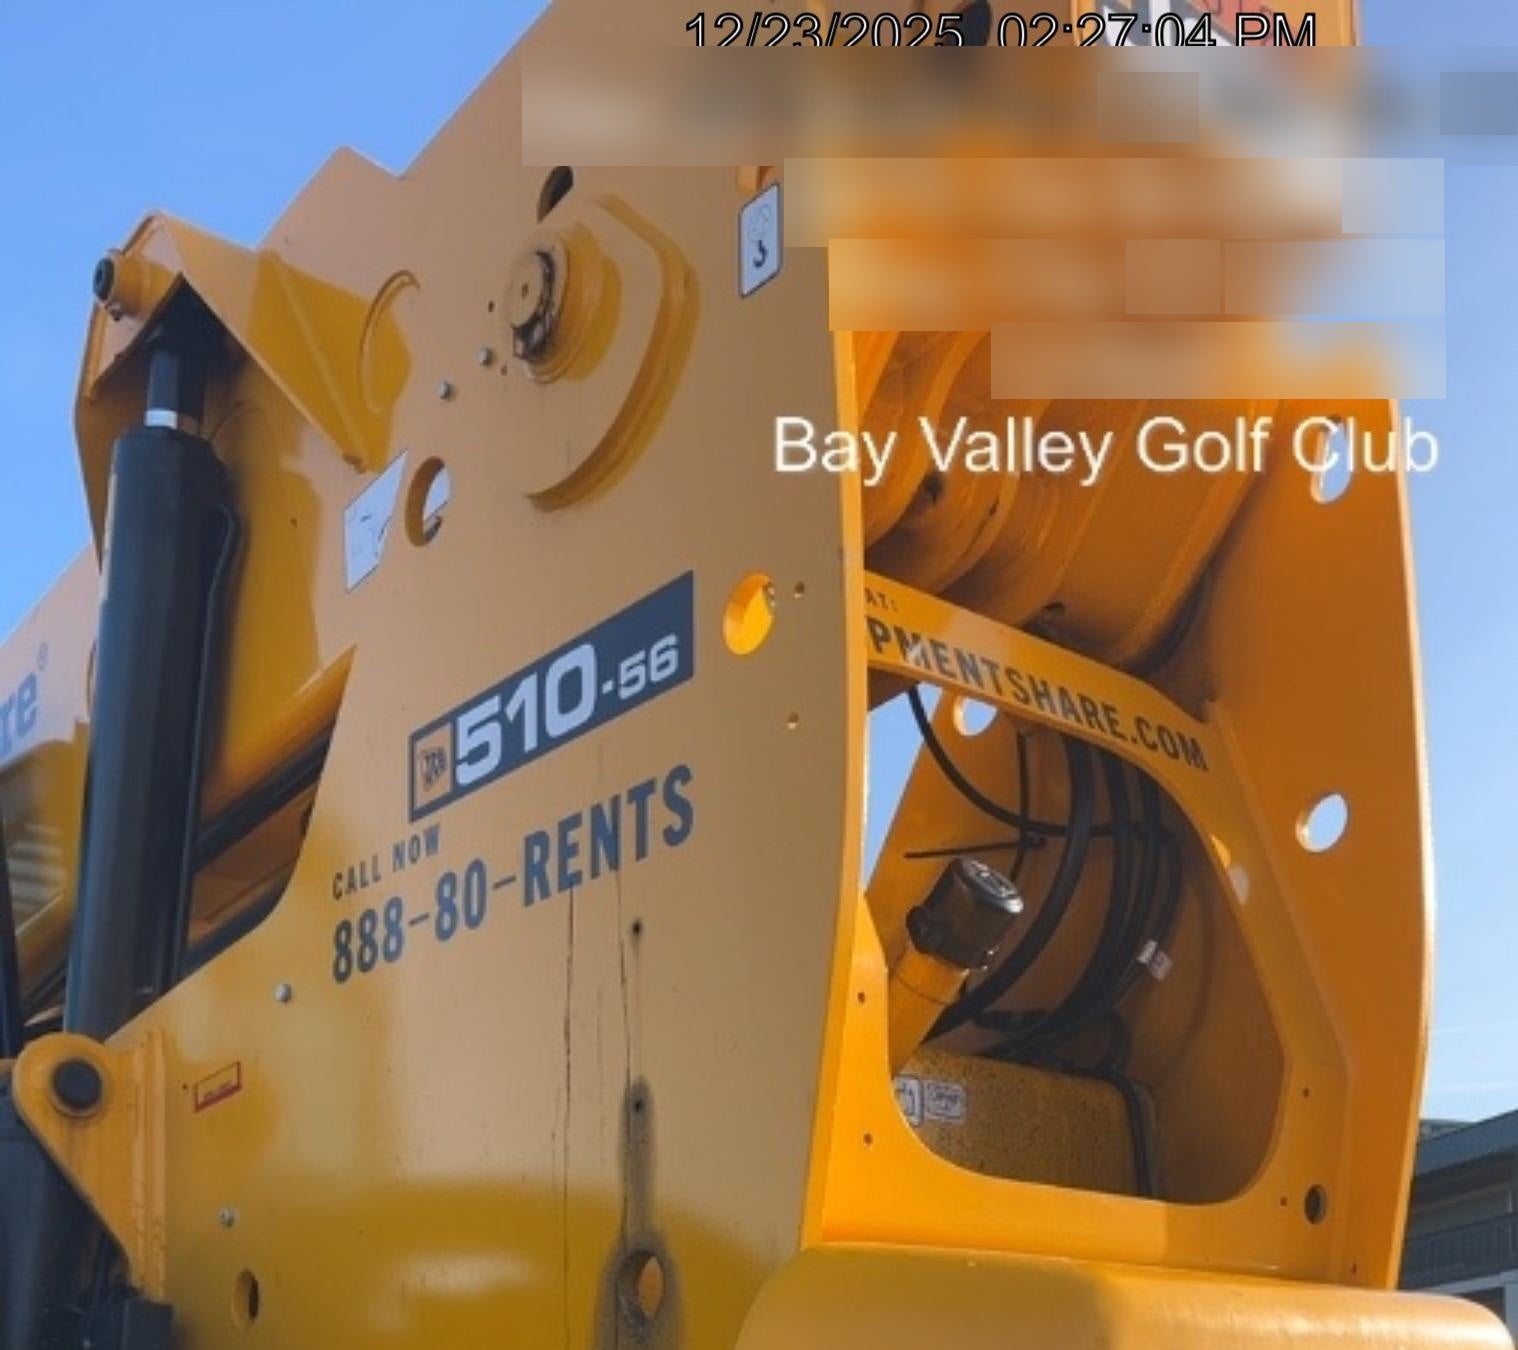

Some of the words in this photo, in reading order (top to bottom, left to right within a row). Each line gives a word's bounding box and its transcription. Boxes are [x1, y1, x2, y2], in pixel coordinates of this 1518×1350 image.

[332, 853, 382, 901] CALL
[392, 822, 441, 873] NOW
[332, 764, 695, 985] 888-80-RENTS
